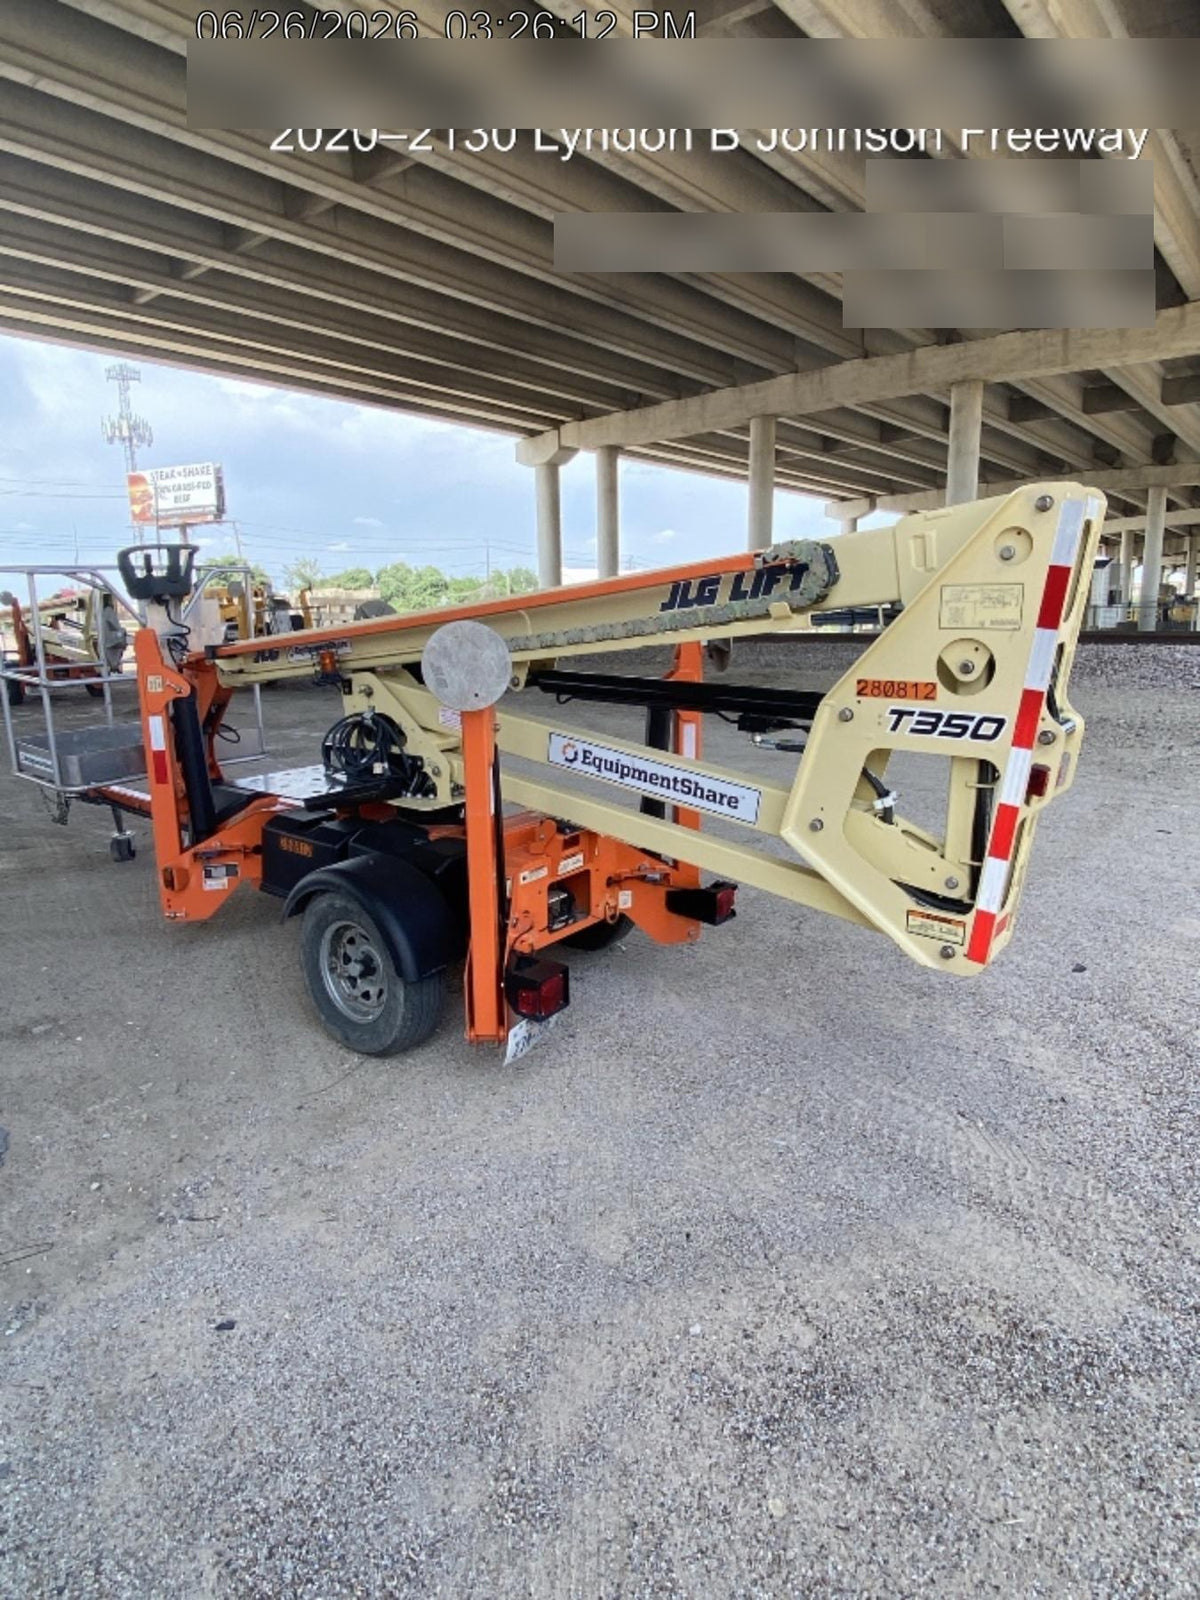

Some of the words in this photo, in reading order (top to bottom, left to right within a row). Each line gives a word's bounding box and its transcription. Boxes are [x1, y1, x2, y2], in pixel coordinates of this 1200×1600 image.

[660, 575, 721, 611] JLG
[729, 562, 809, 601] LIFT
[857, 679, 937, 700] 280812
[888, 708, 1006, 741] T350
[580, 747, 739, 810] EquipmentShare
